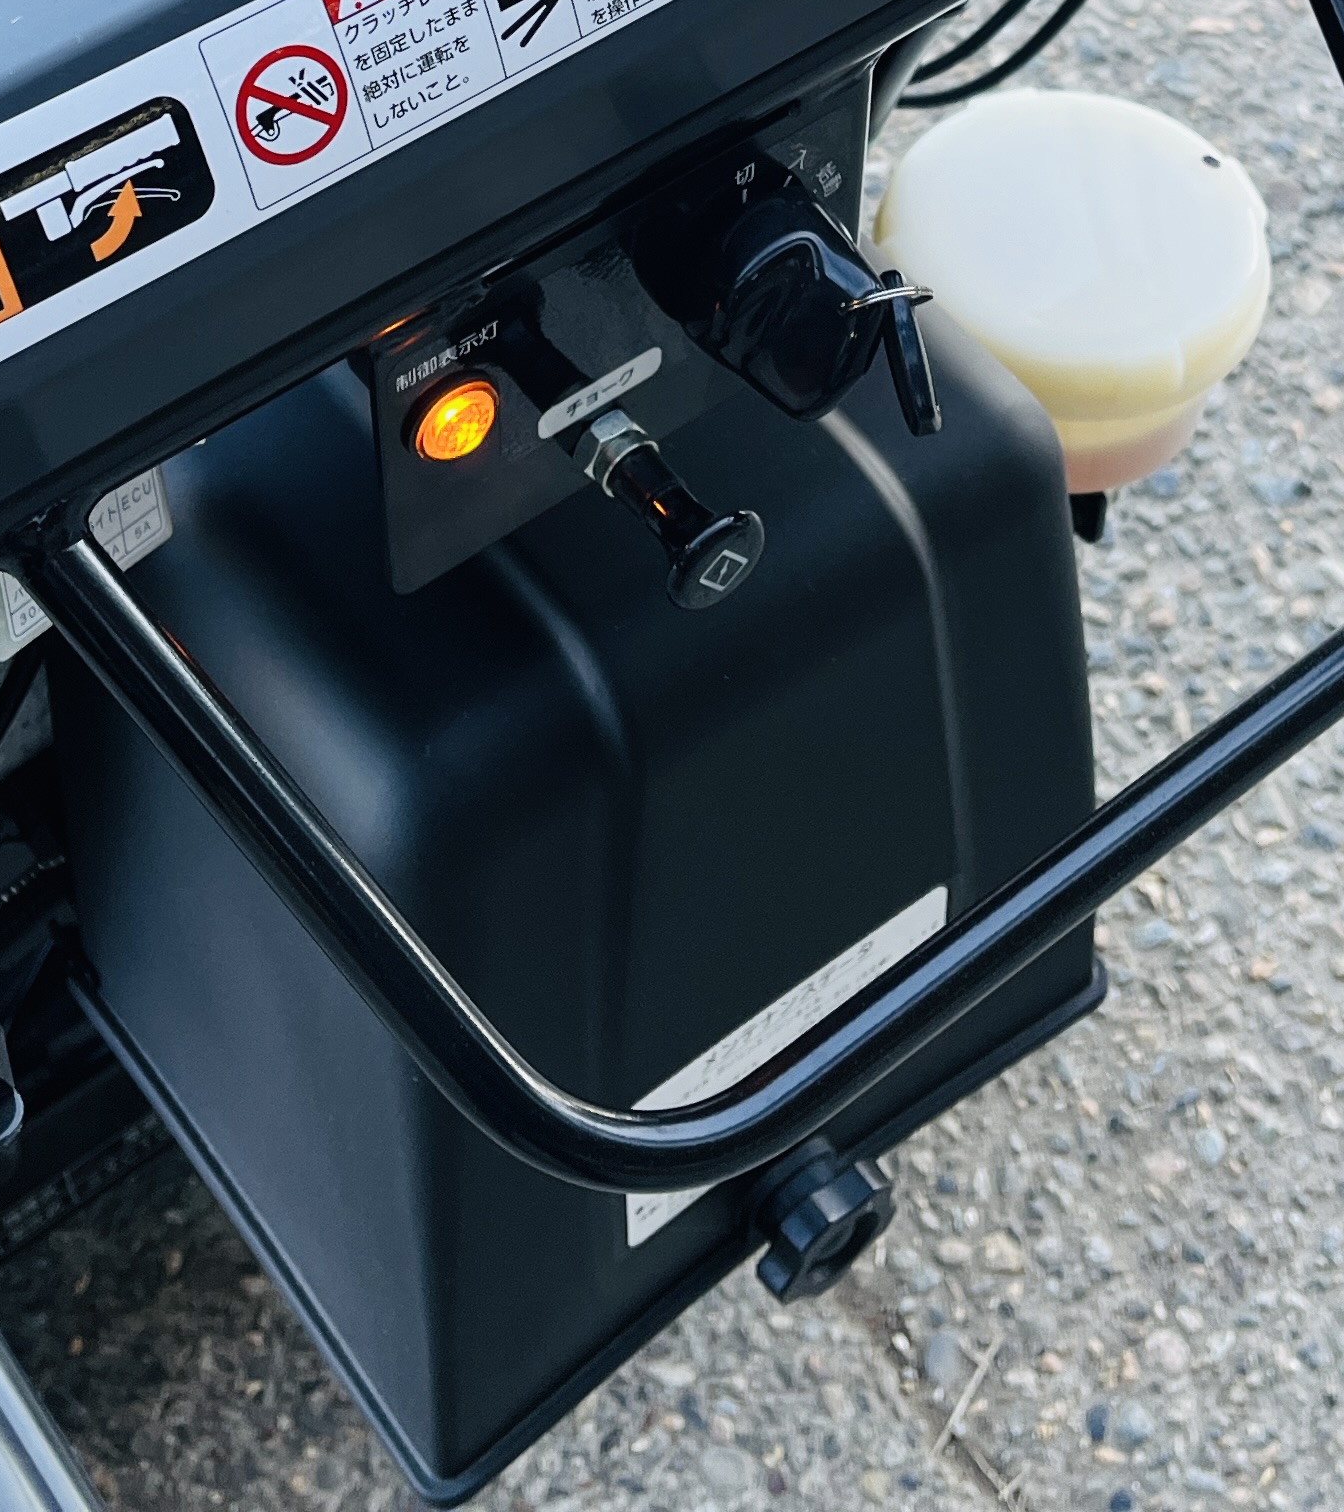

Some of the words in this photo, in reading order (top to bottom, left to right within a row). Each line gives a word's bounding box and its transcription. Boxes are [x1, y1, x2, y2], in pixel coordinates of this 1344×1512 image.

[361, 35, 471, 103] 絶対に運転を
[373, 74, 470, 129] しないこと。
[734, 162, 756, 186] 切
[396, 319, 499, 393] 制御表示灯
[566, 368, 636, 415] チョーク
[120, 478, 153, 512] ECU
